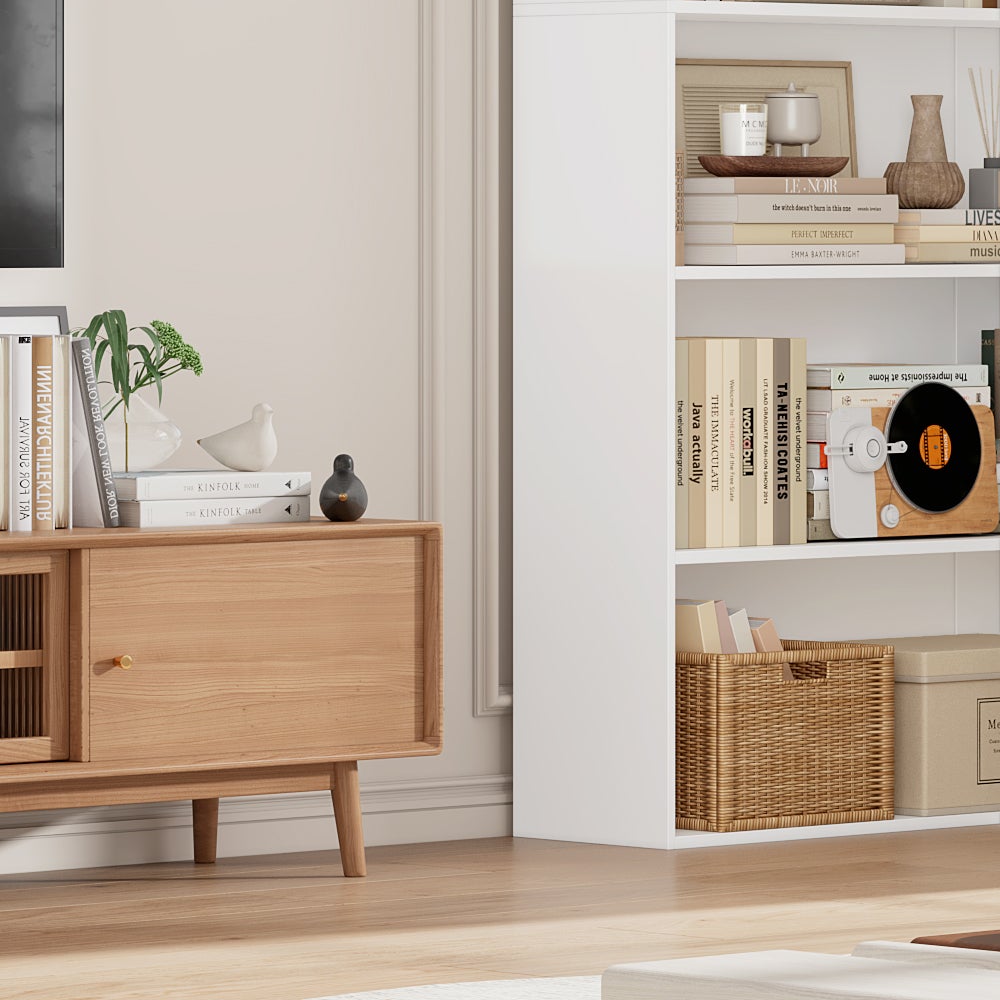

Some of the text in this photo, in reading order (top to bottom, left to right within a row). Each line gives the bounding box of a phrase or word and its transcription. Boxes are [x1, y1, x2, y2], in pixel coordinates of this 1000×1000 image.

[808, 178, 838, 193] NOIR
[792, 230, 853, 238] PERFECT IMPERFECT
[900, 373, 953, 383] Impressionists
[955, 372, 967, 382] The
[689, 402, 703, 484] Java actually
[778, 383, 788, 500] TA-NEHISI COATES
[198, 482, 240, 492] KINFOLK
[200, 507, 241, 517] KINFOLK
